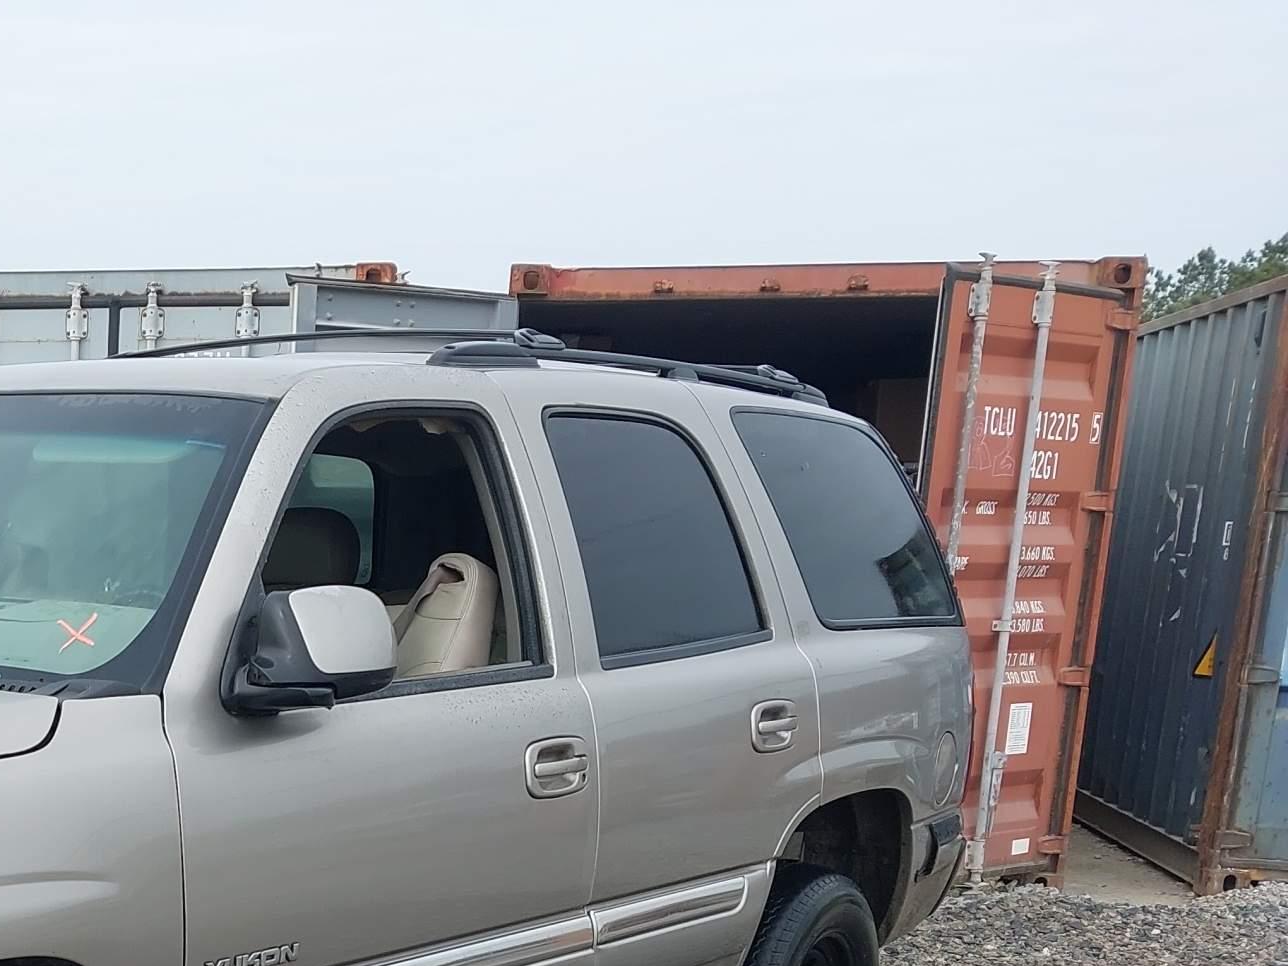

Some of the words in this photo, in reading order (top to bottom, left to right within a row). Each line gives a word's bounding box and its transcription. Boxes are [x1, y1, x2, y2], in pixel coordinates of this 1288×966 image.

[983, 406, 1017, 436] TCLU
[1090, 414, 1102, 442] 5
[976, 501, 998, 515] GROSS
[1020, 546, 1041, 561] 3.660
